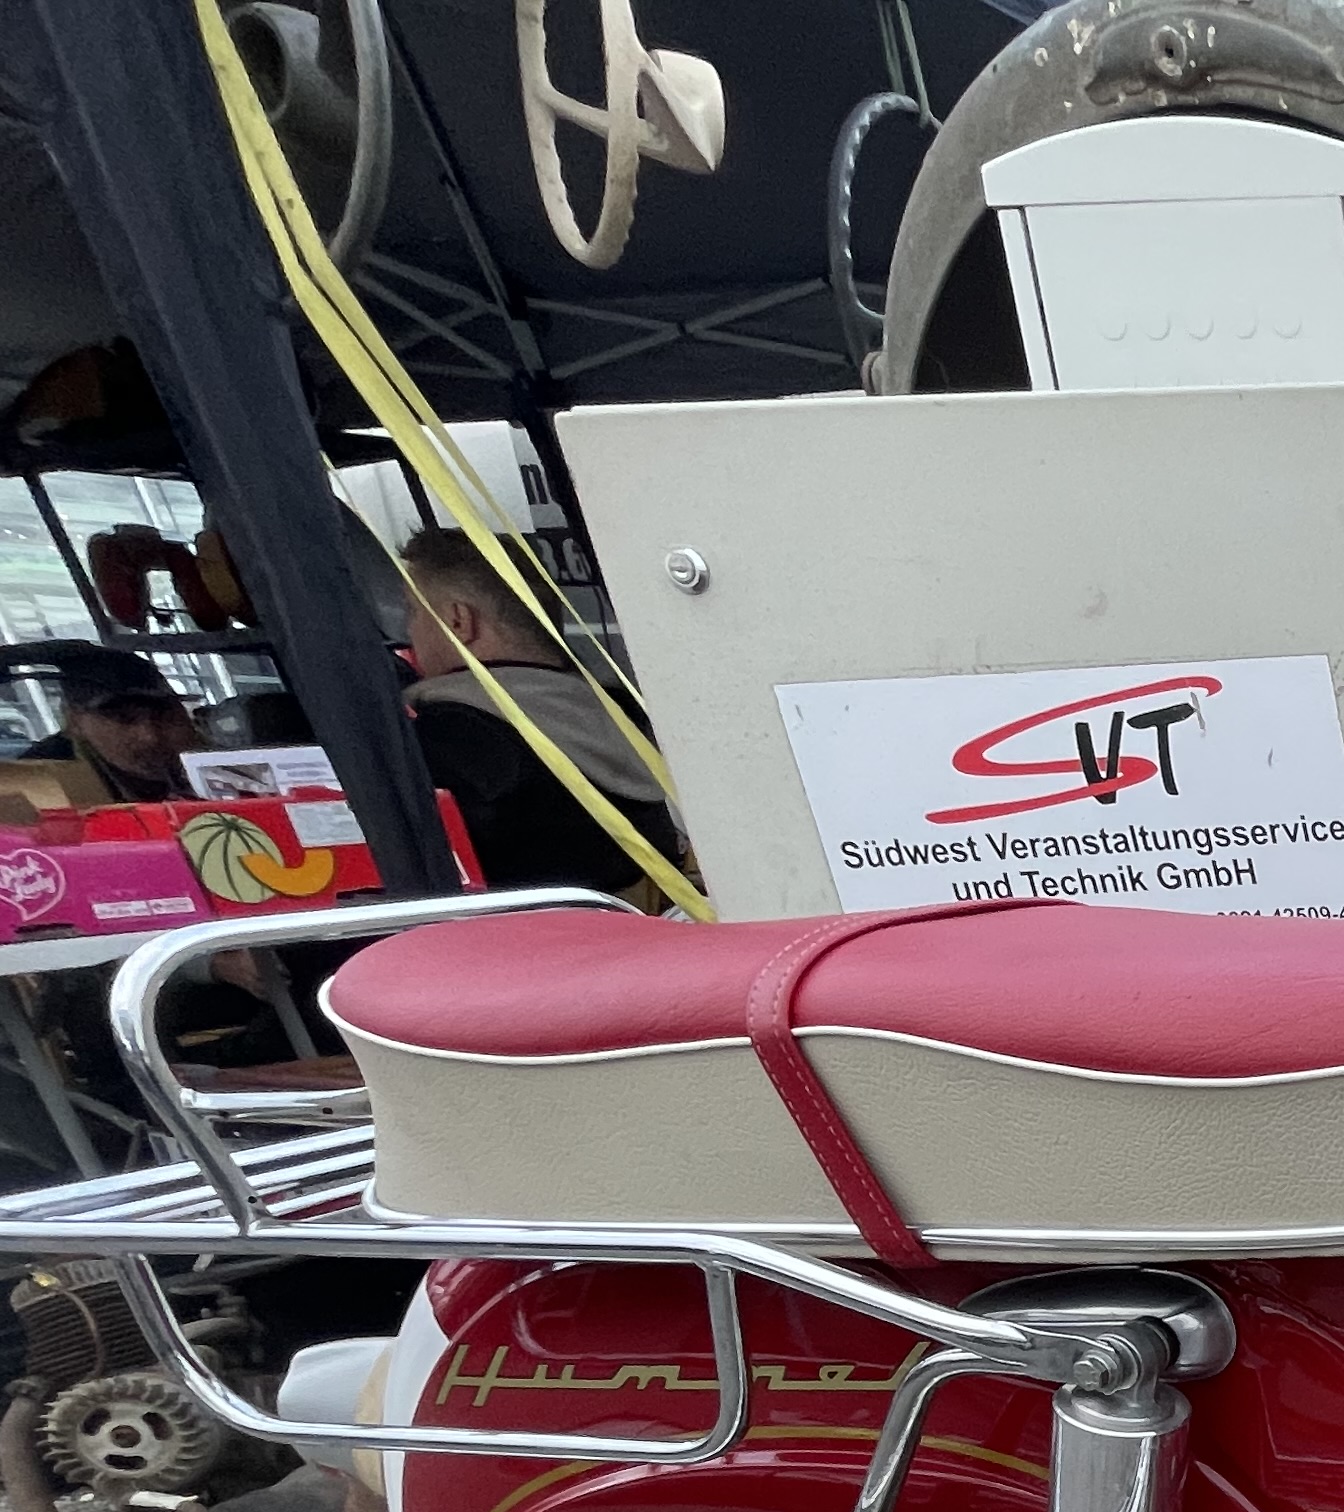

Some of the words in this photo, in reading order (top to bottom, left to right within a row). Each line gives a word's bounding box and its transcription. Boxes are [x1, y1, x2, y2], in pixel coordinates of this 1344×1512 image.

[925, 676, 1223, 824] SVT
[840, 836, 982, 869] Südwest
[952, 872, 1014, 900] und
[1020, 864, 1149, 897] Technik
[1157, 857, 1258, 890] GmbH
